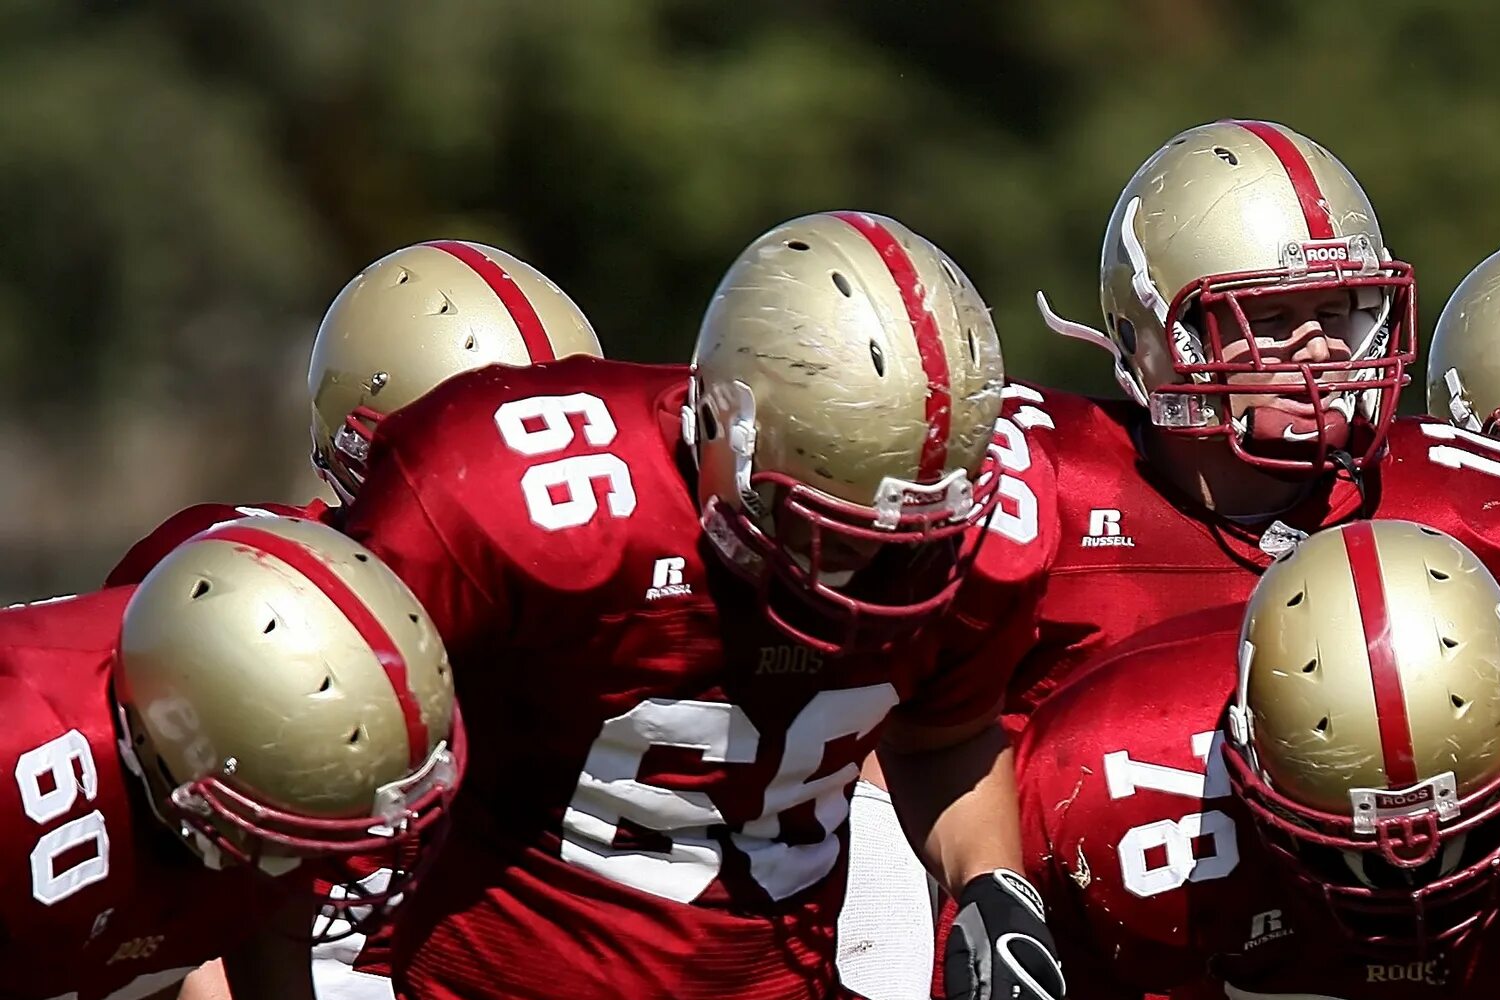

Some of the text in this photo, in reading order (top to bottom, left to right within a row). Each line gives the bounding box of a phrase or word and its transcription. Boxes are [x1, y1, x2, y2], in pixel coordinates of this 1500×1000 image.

[1307, 248, 1347, 262] ROOS
[493, 392, 637, 531] 66
[1081, 536, 1135, 547] RUSSELL
[15, 728, 110, 906] 60
[560, 682, 900, 905] 66
[1104, 729, 1240, 898] 78
[1383, 789, 1429, 806] ROOS
[1244, 928, 1295, 950] RUSSELL
